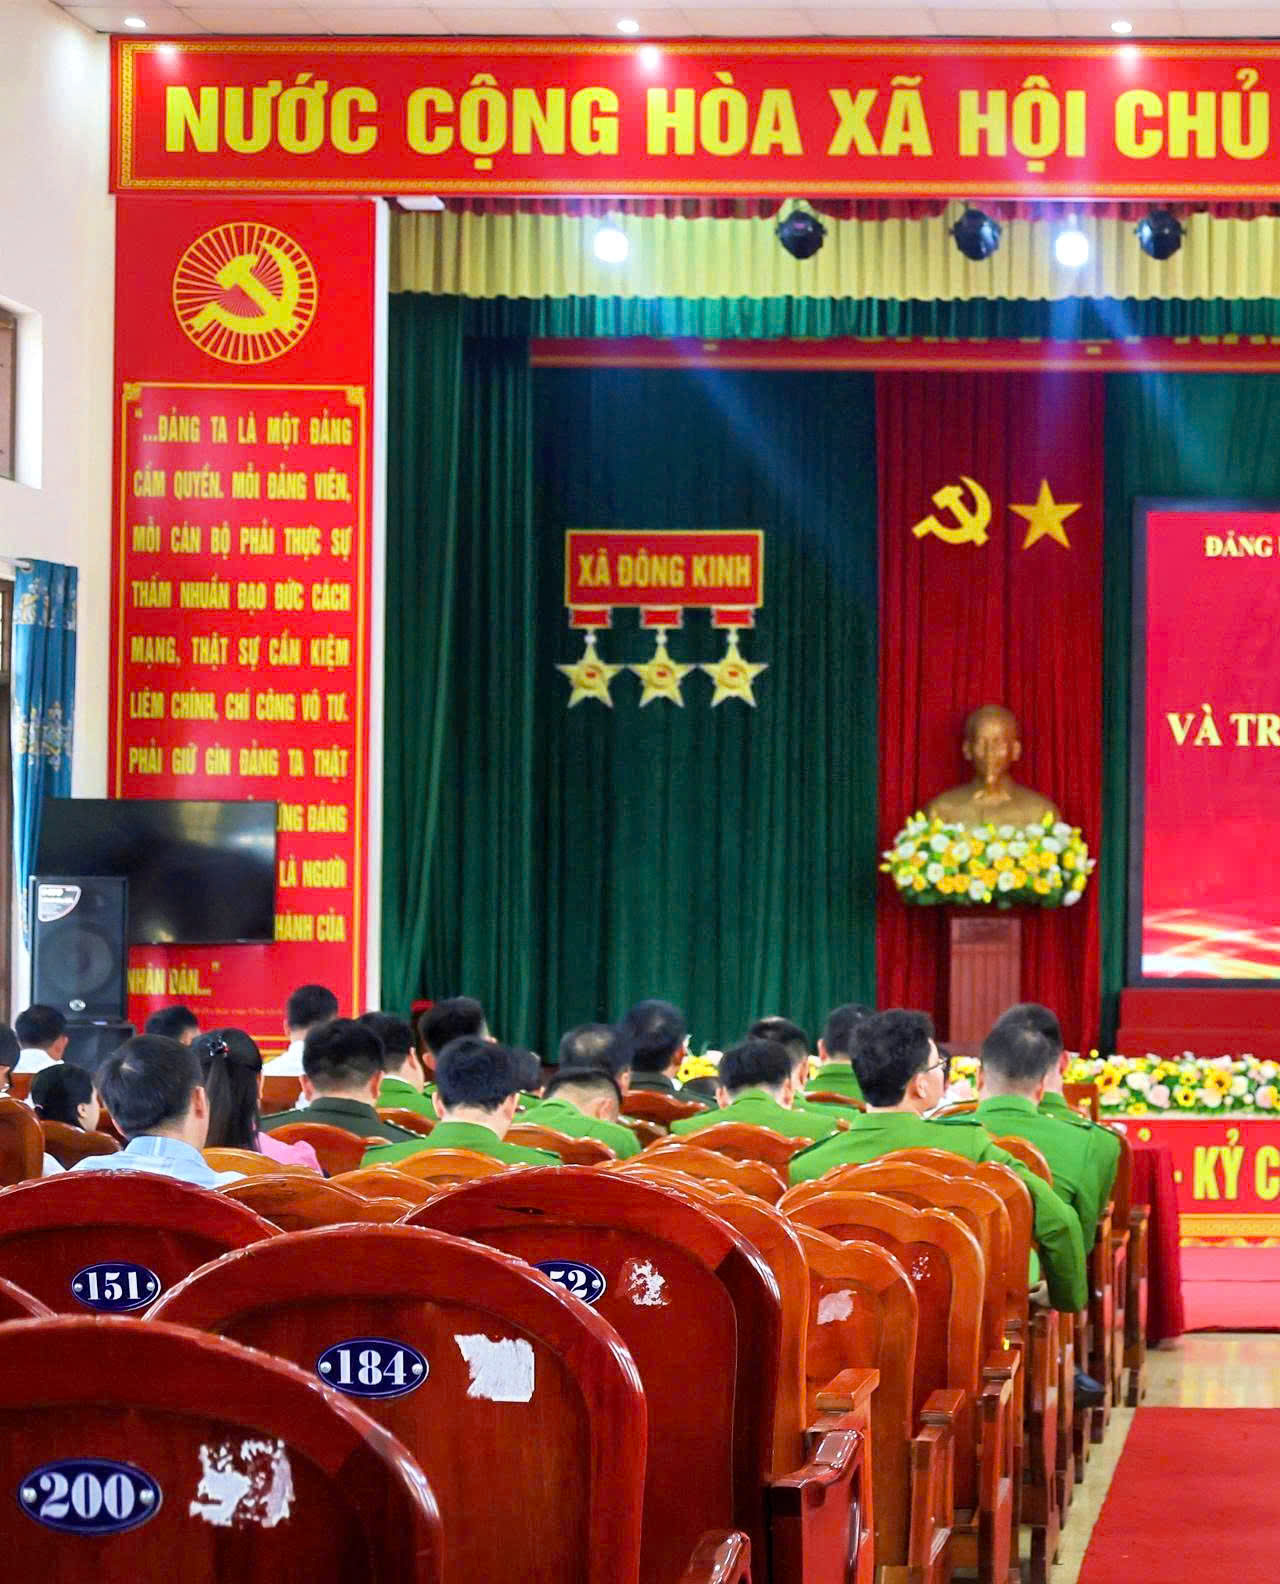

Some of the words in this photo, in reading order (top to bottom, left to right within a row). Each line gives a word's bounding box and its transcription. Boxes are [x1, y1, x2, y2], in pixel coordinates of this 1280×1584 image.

[165, 72, 378, 154] NƯỚC
[406, 73, 619, 170] CỘNG
[646, 71, 804, 155] HÒA
[827, 75, 932, 156] XÃ
[959, 75, 1086, 172] HỘI
[1114, 69, 1270, 159] CHỦ
[211, 416, 228, 443] TA
[238, 410, 257, 444] LÀ
[267, 411, 300, 450] MỘT
[310, 408, 352, 445] ĐẢNG
[267, 463, 307, 499] ĐẢNG
[171, 521, 201, 553] CÁN
[211, 521, 231, 560] BỘ
[240, 518, 275, 555] PHẢI
[284, 525, 321, 561] THỰC
[331, 526, 352, 561] SỰ
[1205, 530, 1272, 557] ĐẢNG
[578, 547, 610, 587] XÃ
[618, 547, 685, 587] ĐÔNG
[692, 555, 751, 587] KINH
[237, 582, 267, 615] ĐẠO
[274, 577, 304, 611] ĐỨC
[312, 577, 350, 611] CÁCH
[192, 632, 228, 671] THẬT
[238, 635, 260, 671] SỰ
[310, 633, 350, 672] KIỆM
[130, 686, 164, 719] LIÊM
[225, 688, 250, 720] CHÍ
[256, 688, 295, 720] CÔNG
[1167, 703, 1222, 747] VÀ
[129, 739, 163, 774] PHẢI
[239, 739, 279, 776] ĐẢNG
[288, 749, 304, 776] TA
[313, 744, 348, 784] THẬT
[279, 853, 297, 888] LÀ
[274, 908, 314, 941] HÀNH
[317, 906, 346, 942] CỦA
[1193, 1127, 1244, 1200] KỶ
[86, 1271, 141, 1301] 151
[549, 1269, 588, 1299] 52
[336, 1348, 407, 1387] 184
[39, 1471, 135, 1520] 200
